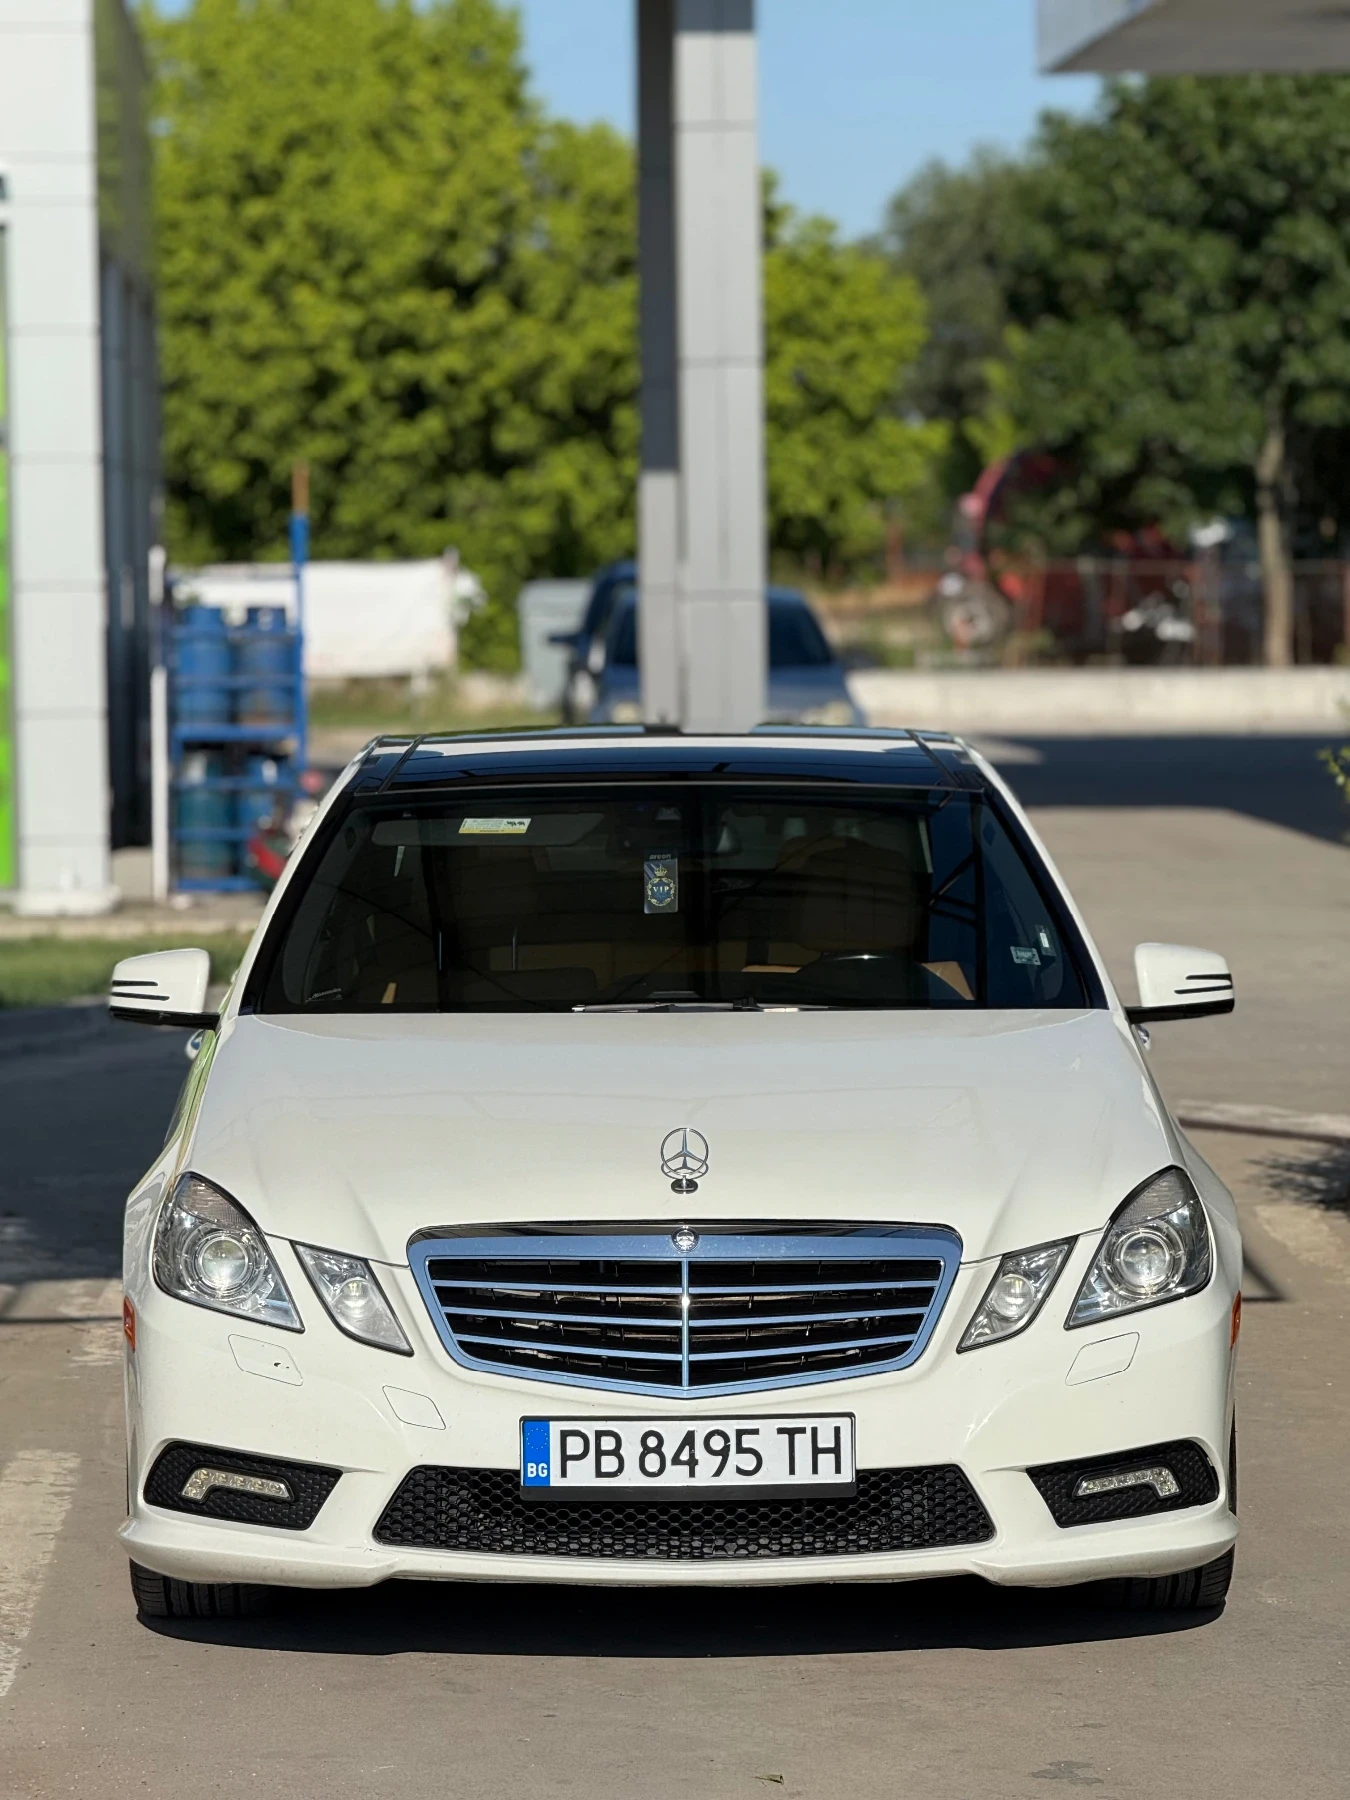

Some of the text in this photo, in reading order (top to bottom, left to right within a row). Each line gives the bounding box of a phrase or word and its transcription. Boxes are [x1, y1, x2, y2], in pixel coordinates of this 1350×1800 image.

[559, 1426, 842, 1479] PB 8495 TH
[527, 1463, 548, 1478] BG
